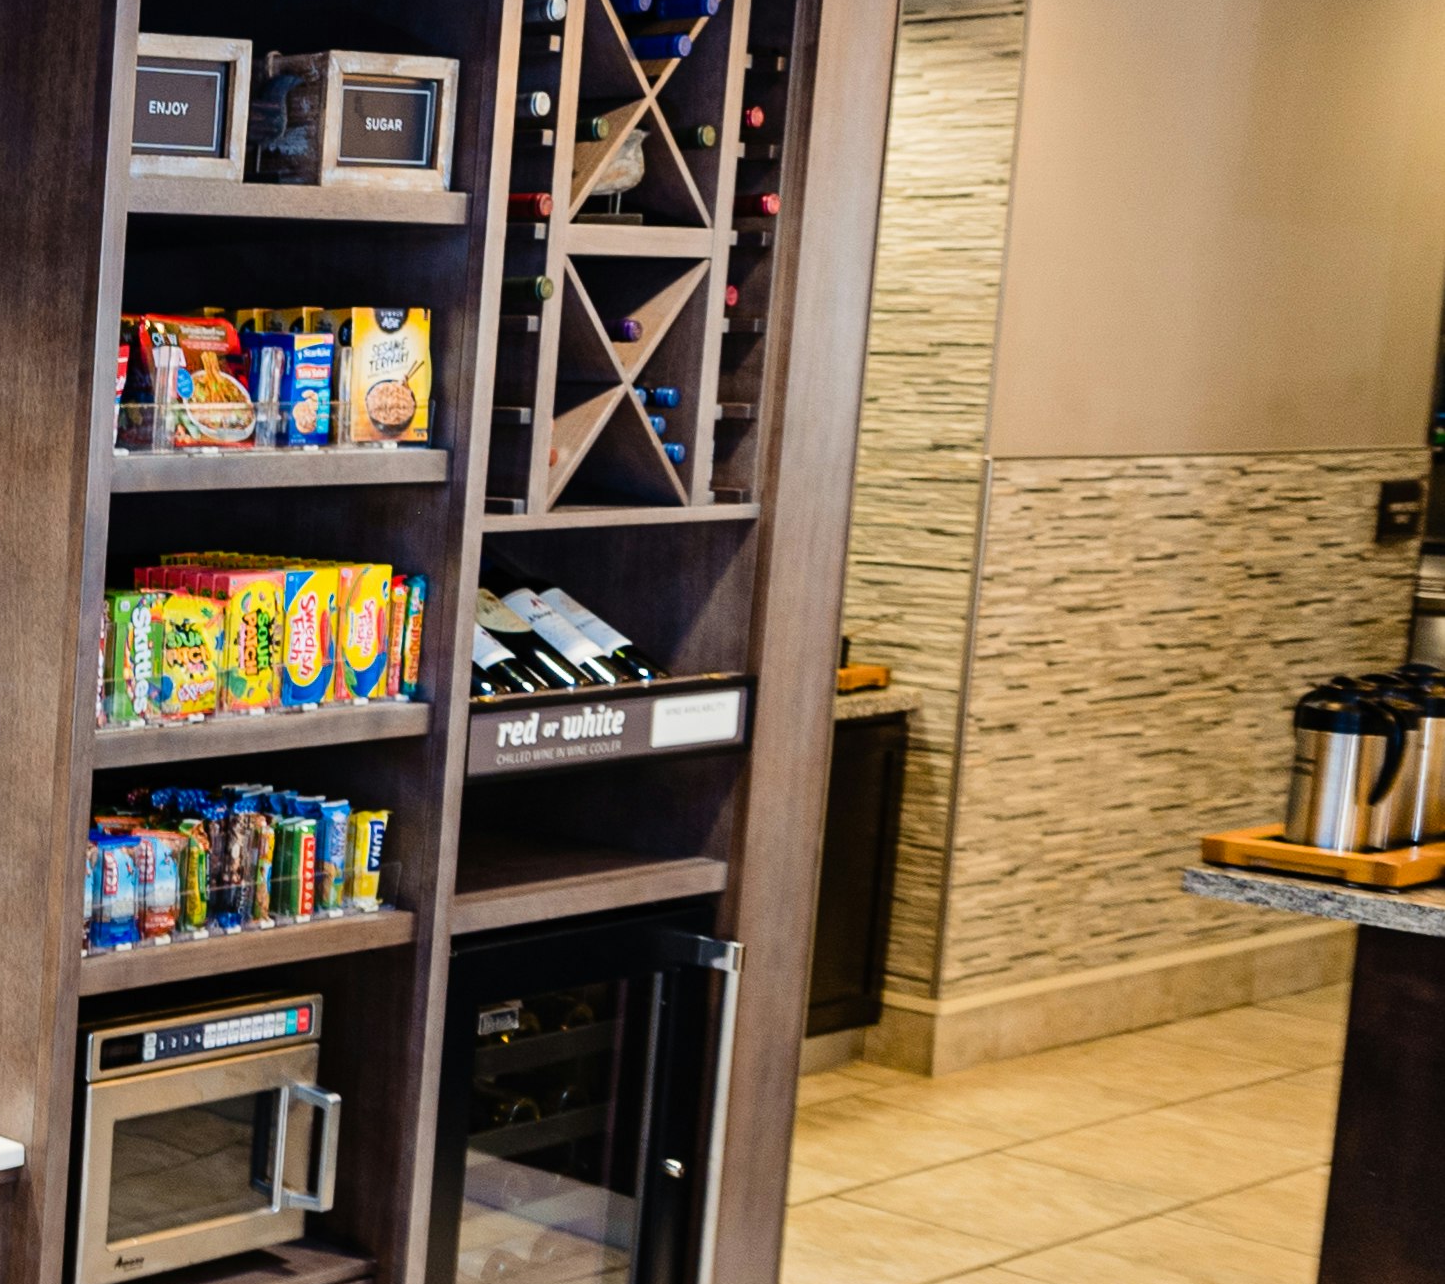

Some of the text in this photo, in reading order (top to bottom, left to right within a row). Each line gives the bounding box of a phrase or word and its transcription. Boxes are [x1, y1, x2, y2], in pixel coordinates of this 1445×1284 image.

[148, 100, 189, 117] ENJOY
[364, 117, 404, 133] SUGAR
[132, 606, 152, 715] Skittles
[245, 613, 258, 675] PATCH
[256, 611, 269, 670] SOUR
[290, 616, 303, 665] Fish
[300, 594, 317, 679] Swedish
[496, 703, 626, 748] red or white
[495, 749, 532, 766] CHILLED
[532, 748, 554, 763] WINE
[566, 744, 588, 759] WINE
[589, 739, 622, 756] COOLER
[370, 821, 384, 869] LUNA
